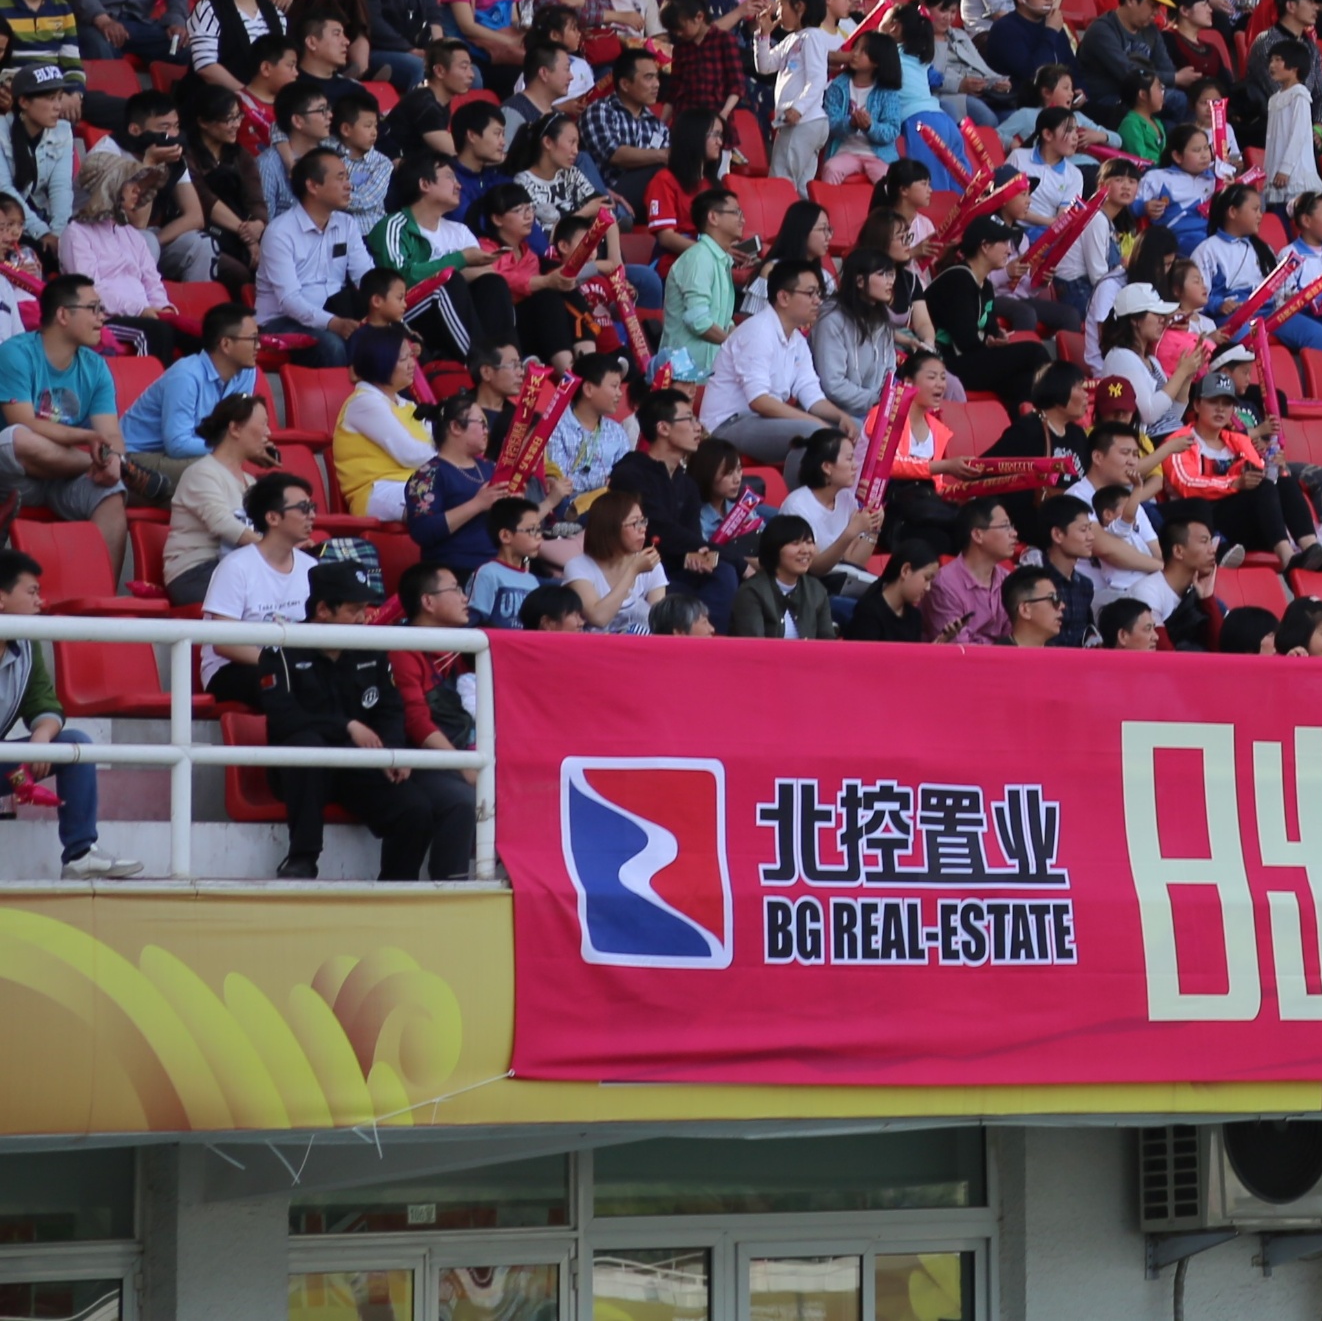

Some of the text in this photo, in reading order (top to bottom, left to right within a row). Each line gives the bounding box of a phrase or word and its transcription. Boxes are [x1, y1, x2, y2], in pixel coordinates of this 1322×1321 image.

[756, 778, 1070, 889] 北控置业
[764, 897, 1078, 967] BG REAL-ESTATE
